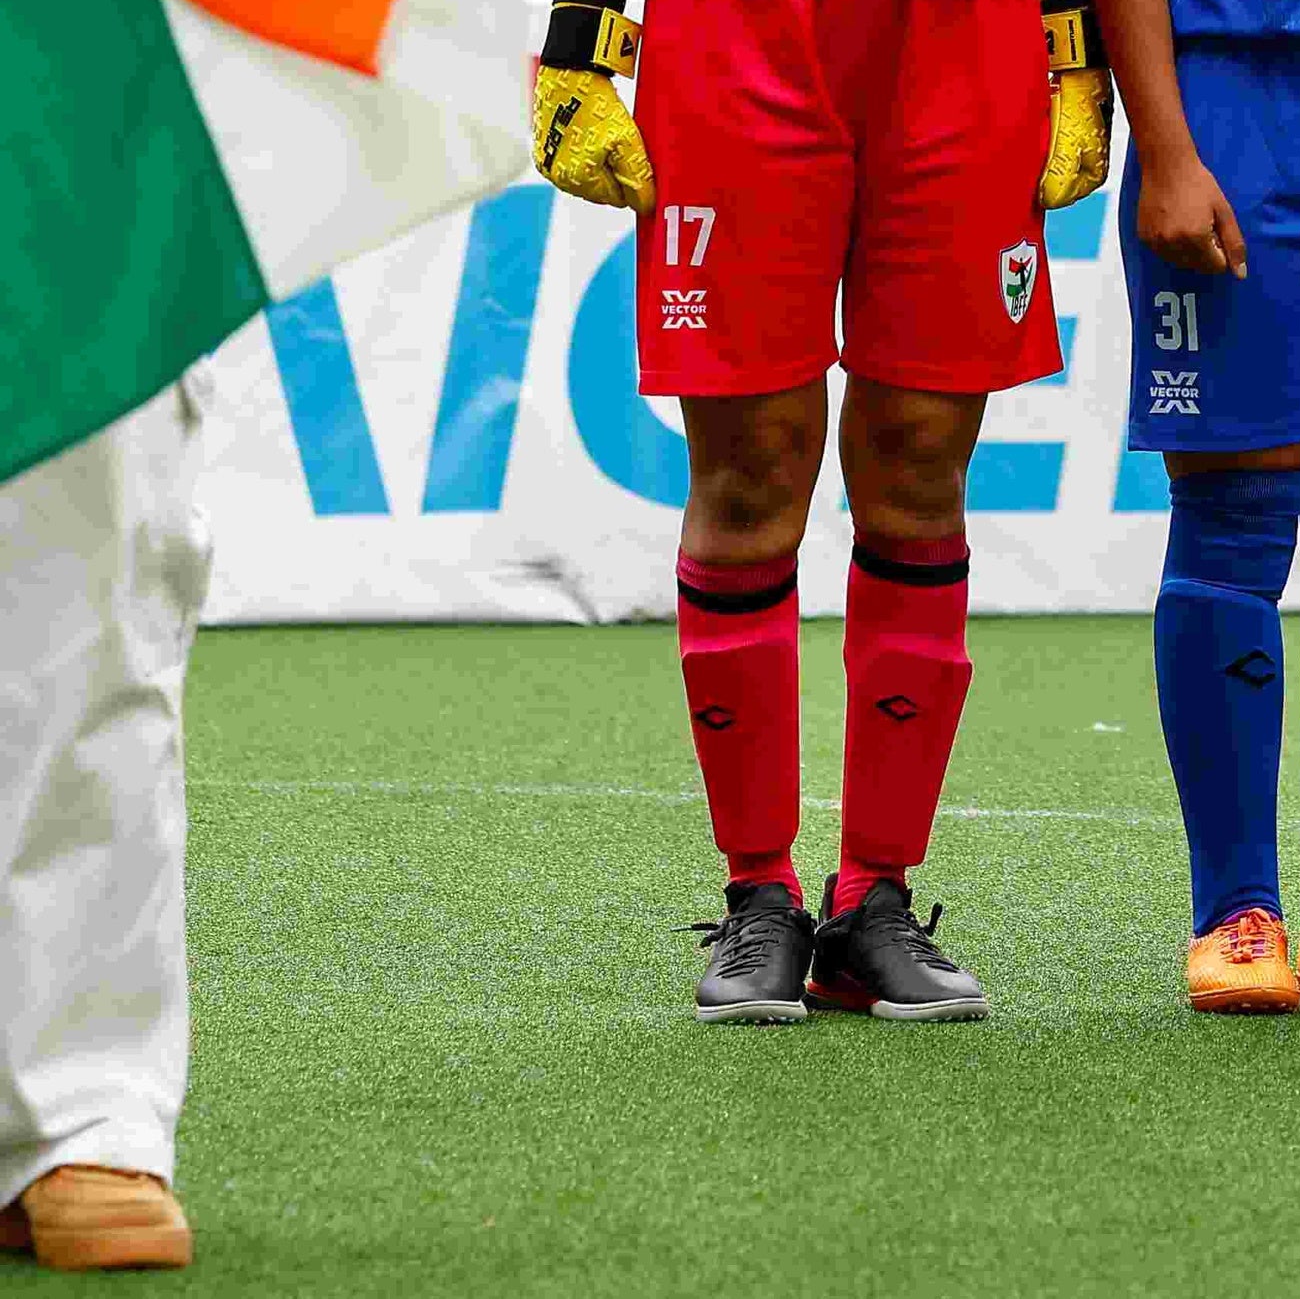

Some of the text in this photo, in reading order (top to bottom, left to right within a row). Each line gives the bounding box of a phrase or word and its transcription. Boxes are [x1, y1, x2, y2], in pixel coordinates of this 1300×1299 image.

[663, 205, 716, 267] 17
[661, 304, 707, 315] VECTOR
[1154, 293, 1199, 351] 31
[1149, 386, 1199, 398] VECTOR
